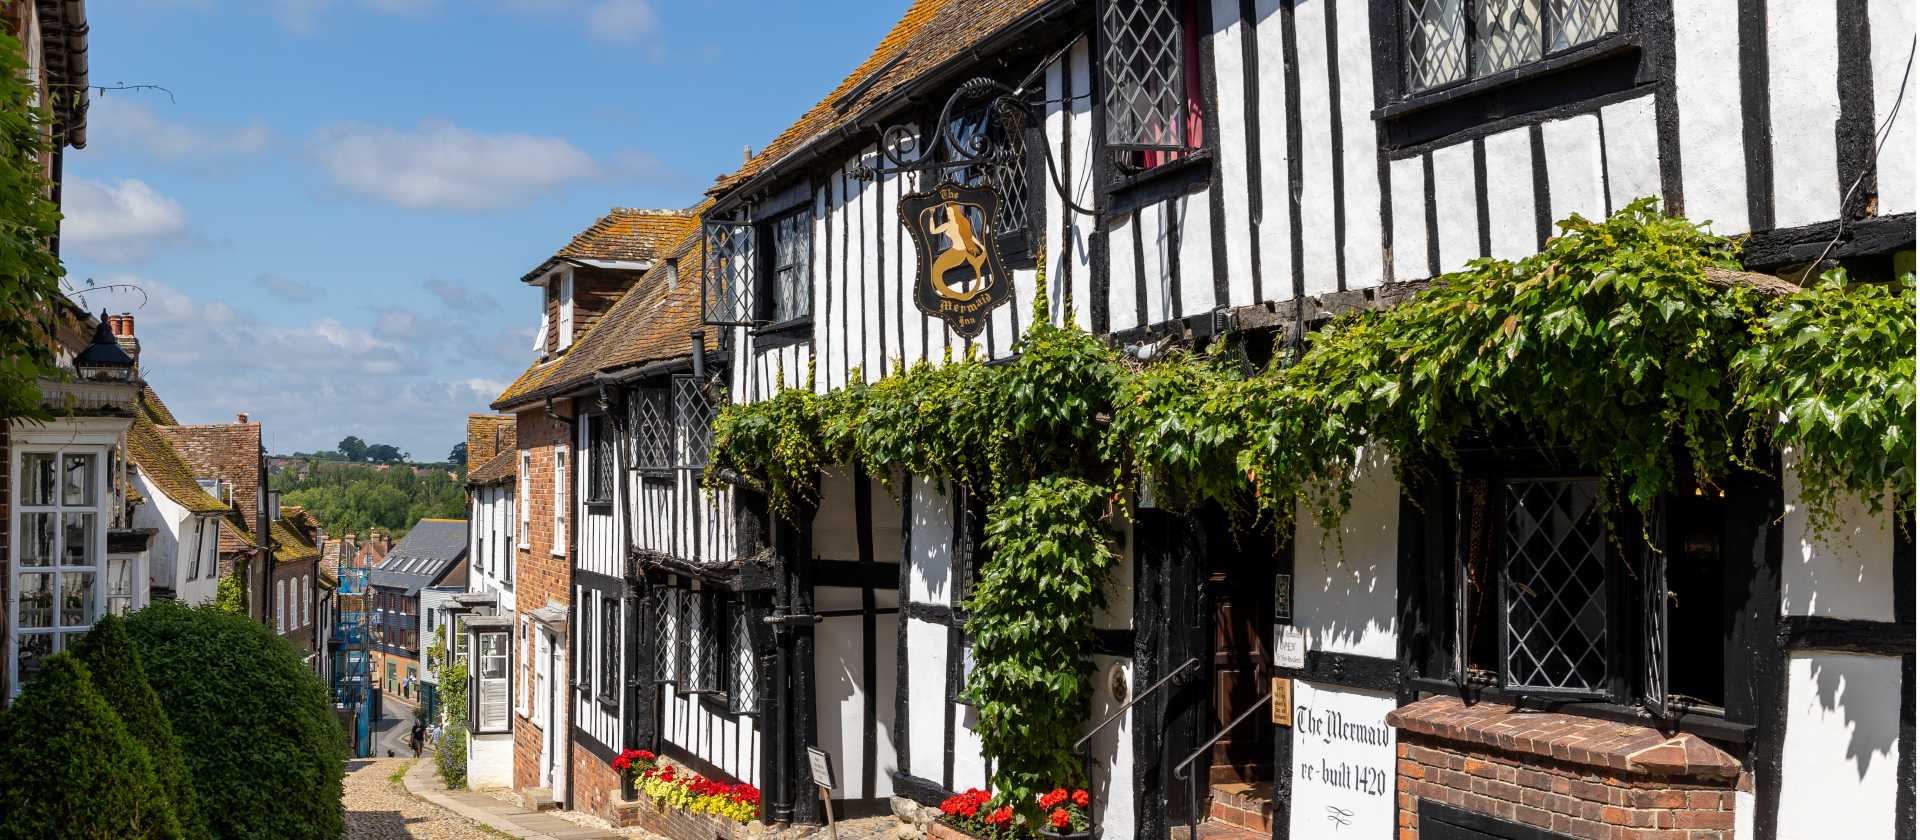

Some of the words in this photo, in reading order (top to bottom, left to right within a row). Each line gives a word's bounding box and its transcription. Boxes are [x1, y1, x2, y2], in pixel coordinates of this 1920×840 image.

[940, 188, 959, 199] The
[939, 293, 991, 314] Mermaid
[959, 316, 975, 327] Inn
[1297, 705, 1323, 736] The
[1323, 709, 1389, 747] Mermaid
[1301, 757, 1350, 790] re-built
[1354, 764, 1386, 796] 1420
